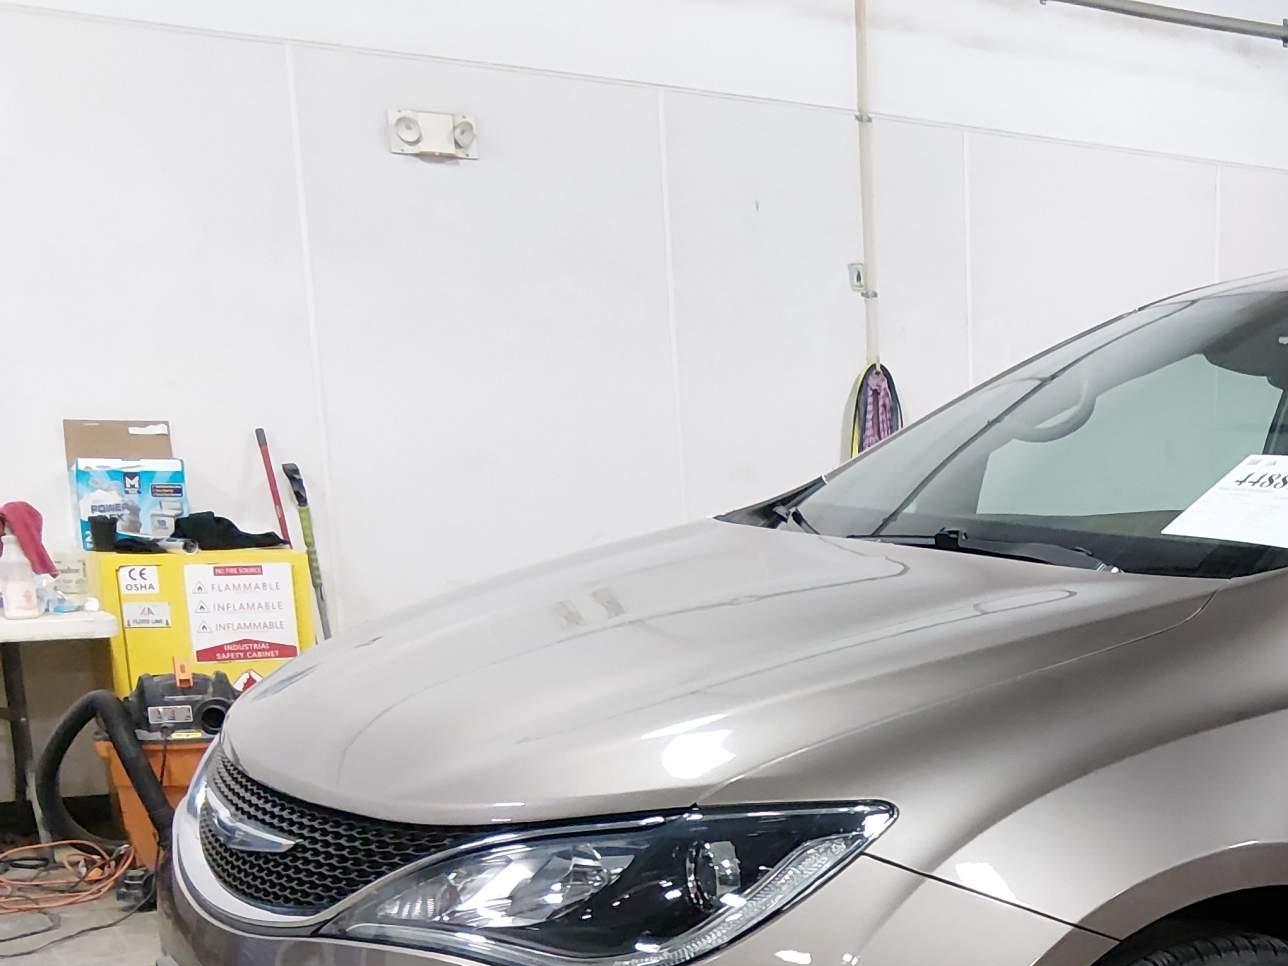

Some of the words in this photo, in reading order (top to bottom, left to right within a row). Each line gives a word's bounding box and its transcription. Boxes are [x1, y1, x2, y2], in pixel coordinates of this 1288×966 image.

[128, 567, 148, 581] CE
[125, 583, 155, 592] OSHA
[211, 582, 281, 592] FLAMMABLE
[213, 601, 284, 612] INFLAMABLE
[215, 621, 285, 632] INFLAMMABLE
[224, 643, 270, 651] INDUSTRIAL
[216, 651, 245, 660] SAFETY
[247, 650, 279, 658] CABINET
